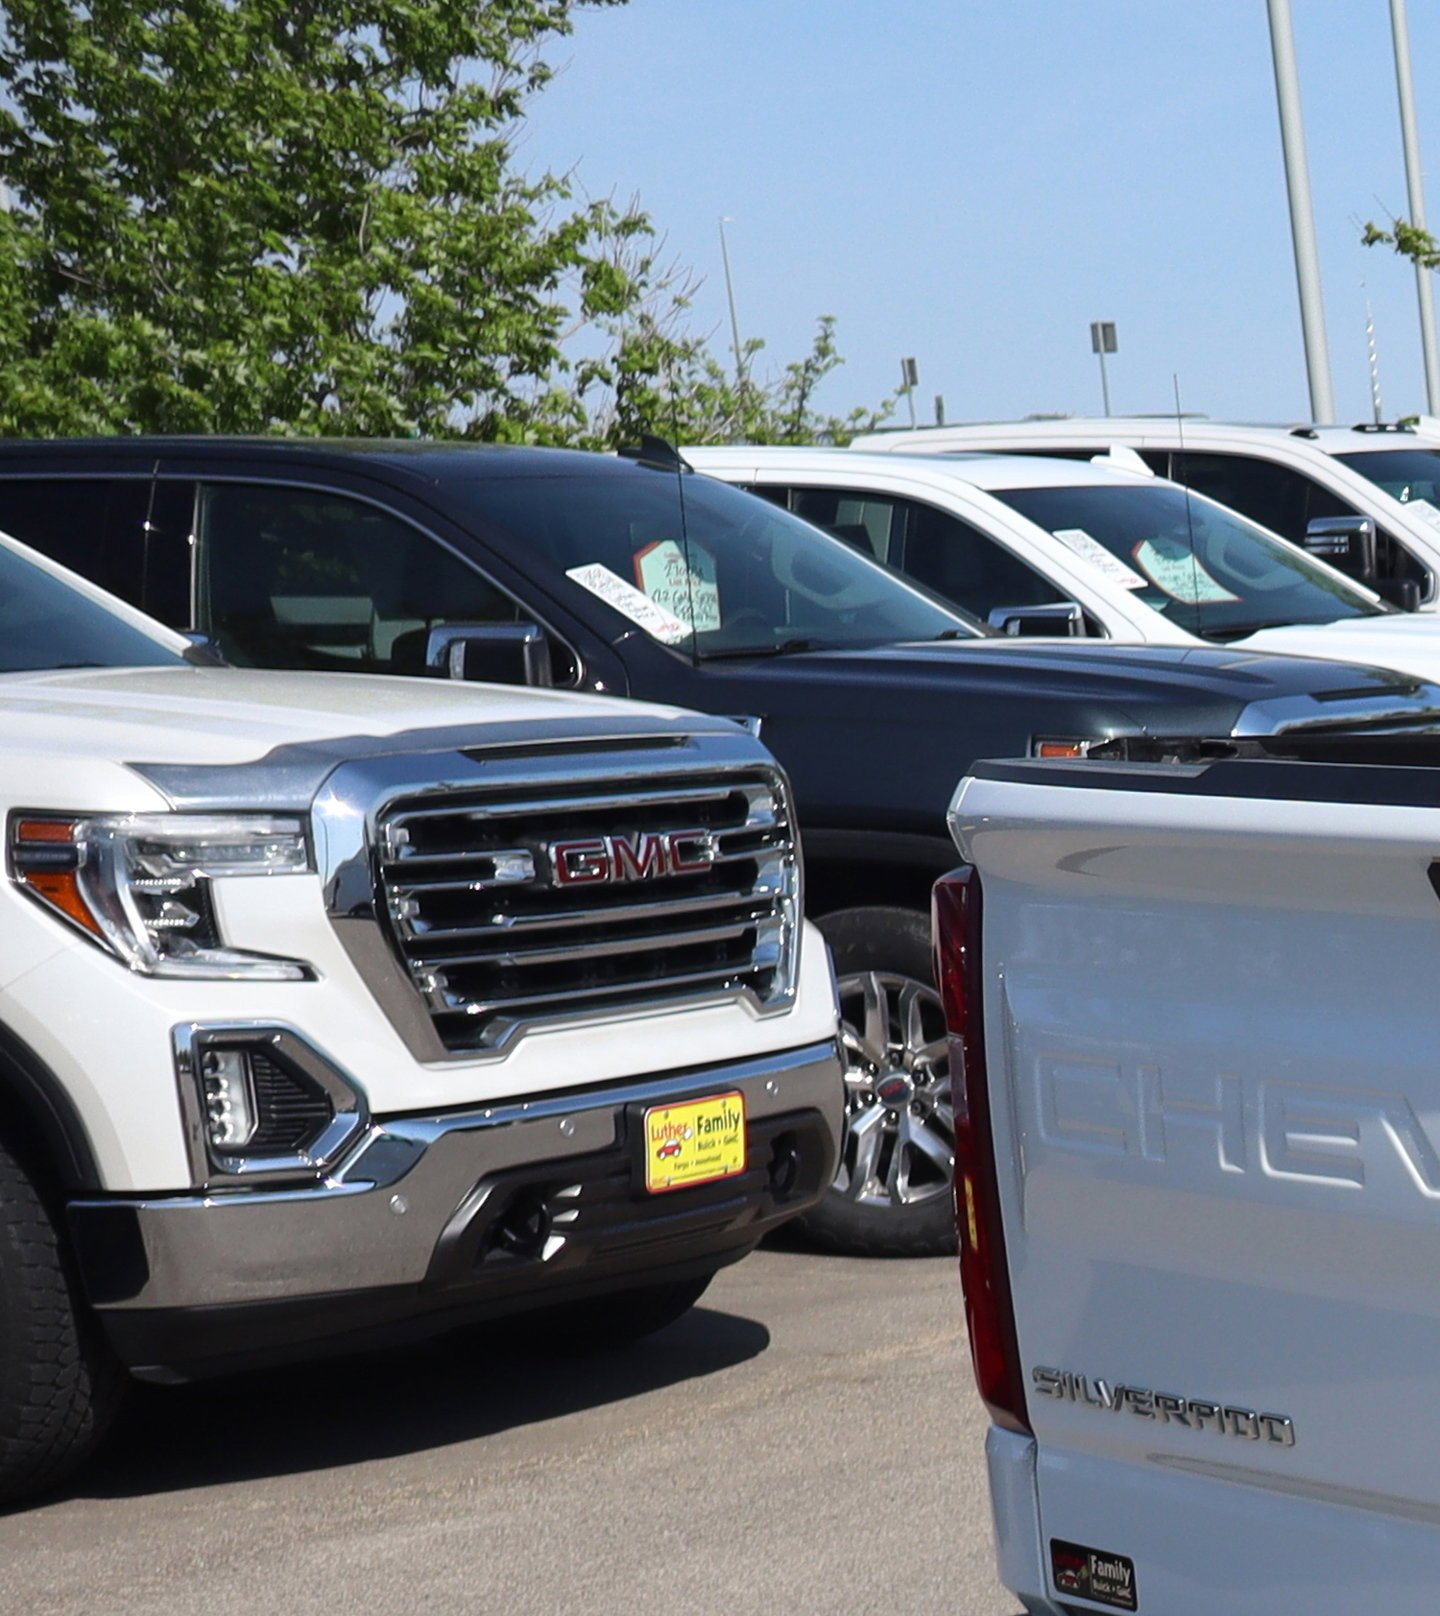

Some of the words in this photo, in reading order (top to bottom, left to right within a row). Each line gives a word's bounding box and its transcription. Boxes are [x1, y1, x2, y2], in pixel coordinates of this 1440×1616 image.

[549, 829, 713, 888] GMC
[651, 1121, 686, 1141] Luther
[697, 1109, 740, 1136] Family
[1033, 1364, 1295, 1448] SILVERADO
[1091, 1555, 1131, 1587] Family
